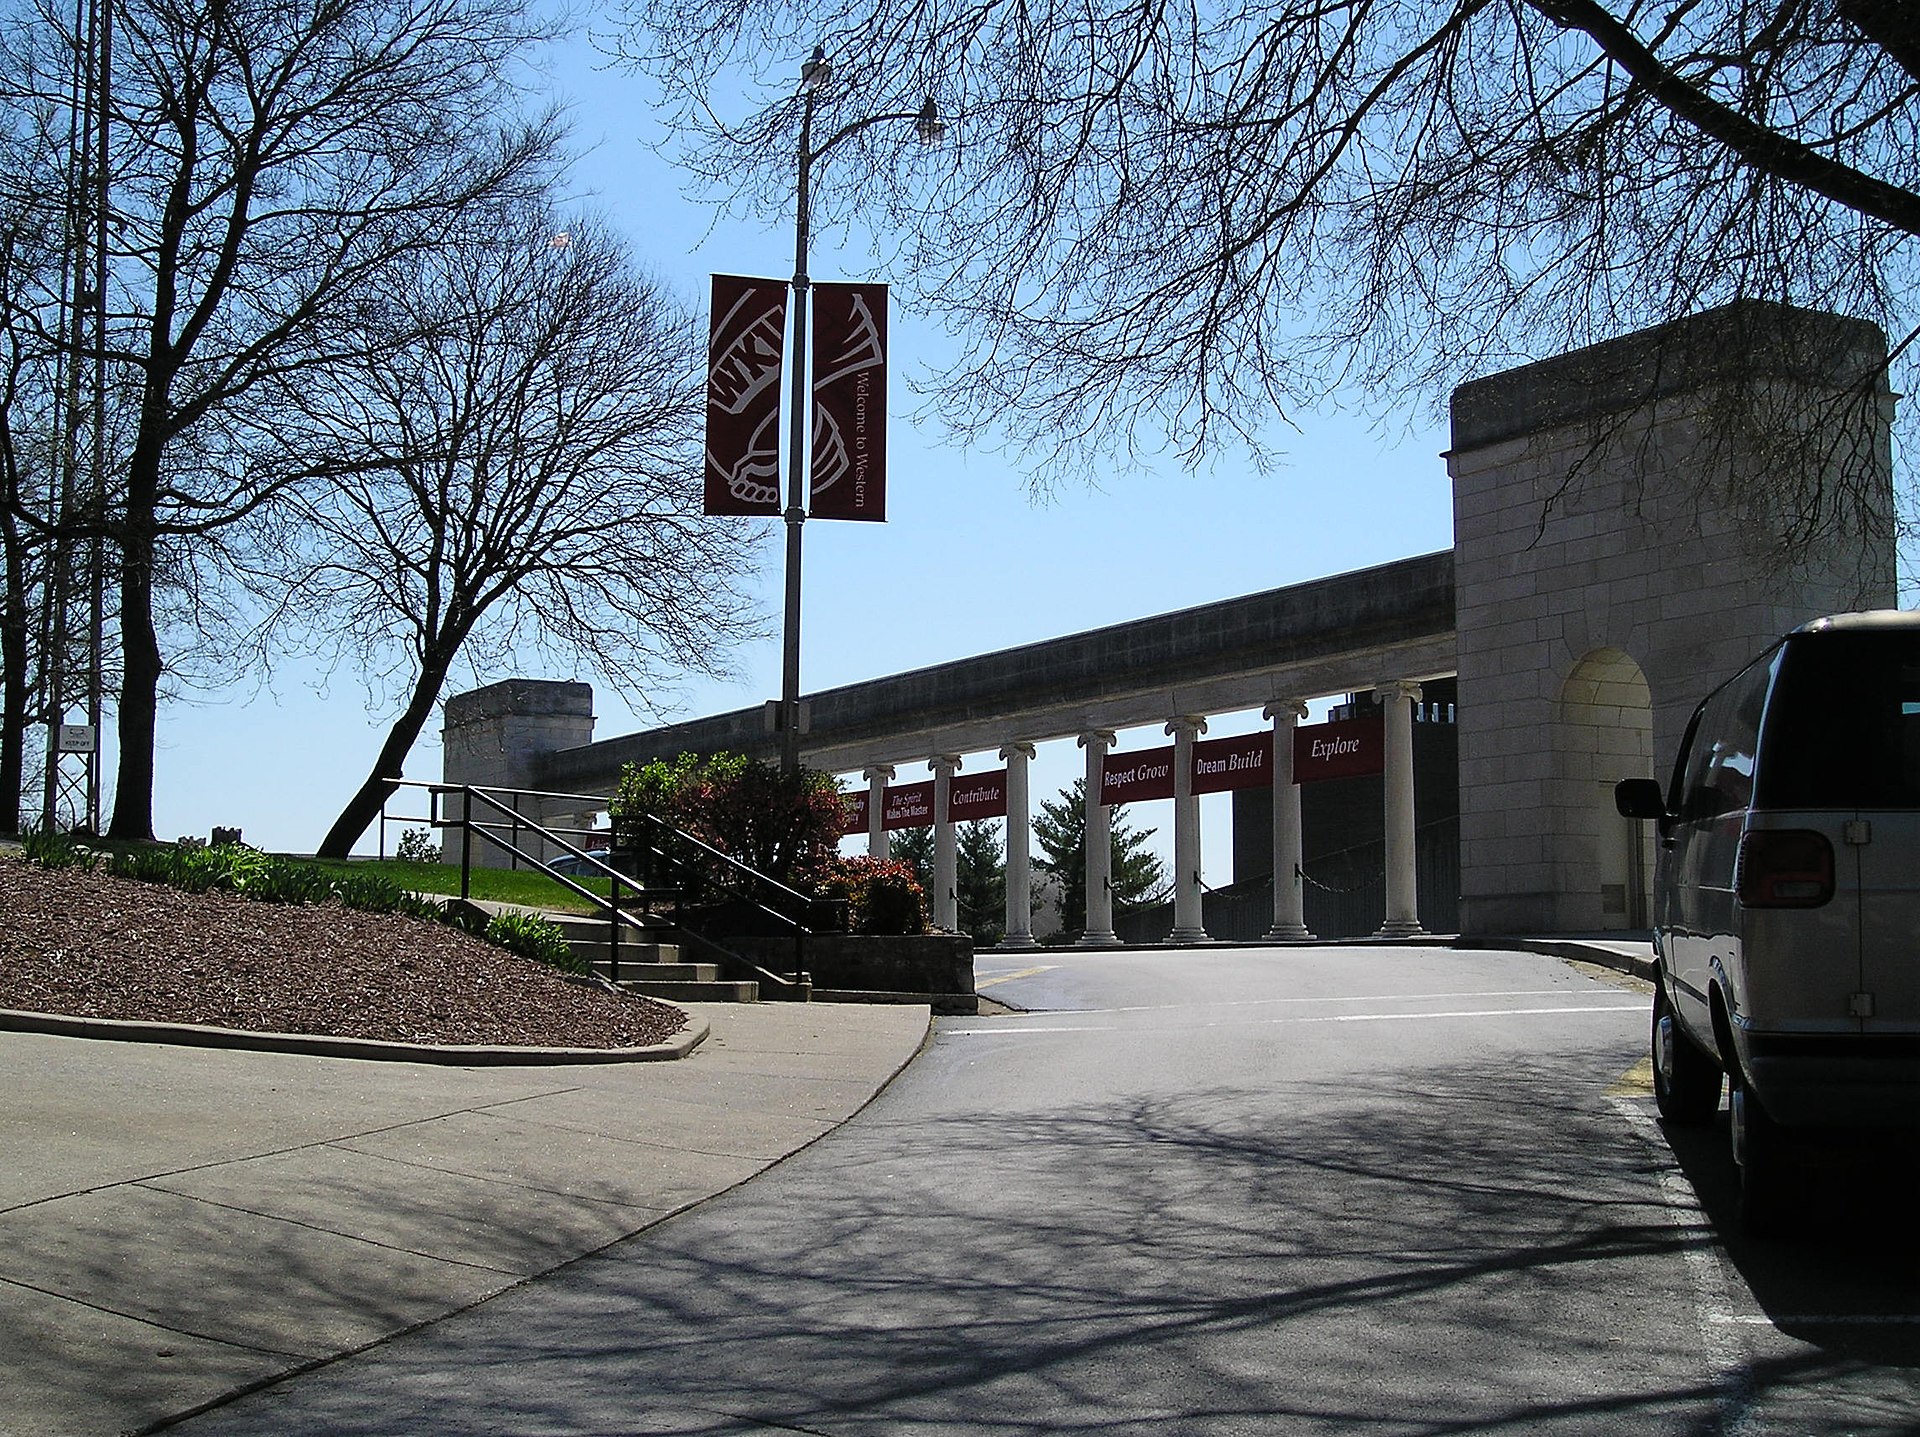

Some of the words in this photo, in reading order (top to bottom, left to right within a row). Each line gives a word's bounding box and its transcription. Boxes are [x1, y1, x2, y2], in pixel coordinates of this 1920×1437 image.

[856, 371, 870, 433] Welcome
[856, 437, 868, 450] to
[855, 453, 869, 508] Western
[1311, 737, 1360, 762] Explore
[1196, 758, 1227, 775] Dream
[1228, 750, 1264, 771] Build
[1104, 768, 1136, 788] Respect
[1137, 763, 1169, 781] Grow
[892, 795, 902, 807] The
[903, 791, 922, 808] Spirit
[952, 786, 1000, 806] Contribute
[886, 806, 901, 820] Makes
[901, 806, 911, 818] The
[910, 805, 929, 817] Master
